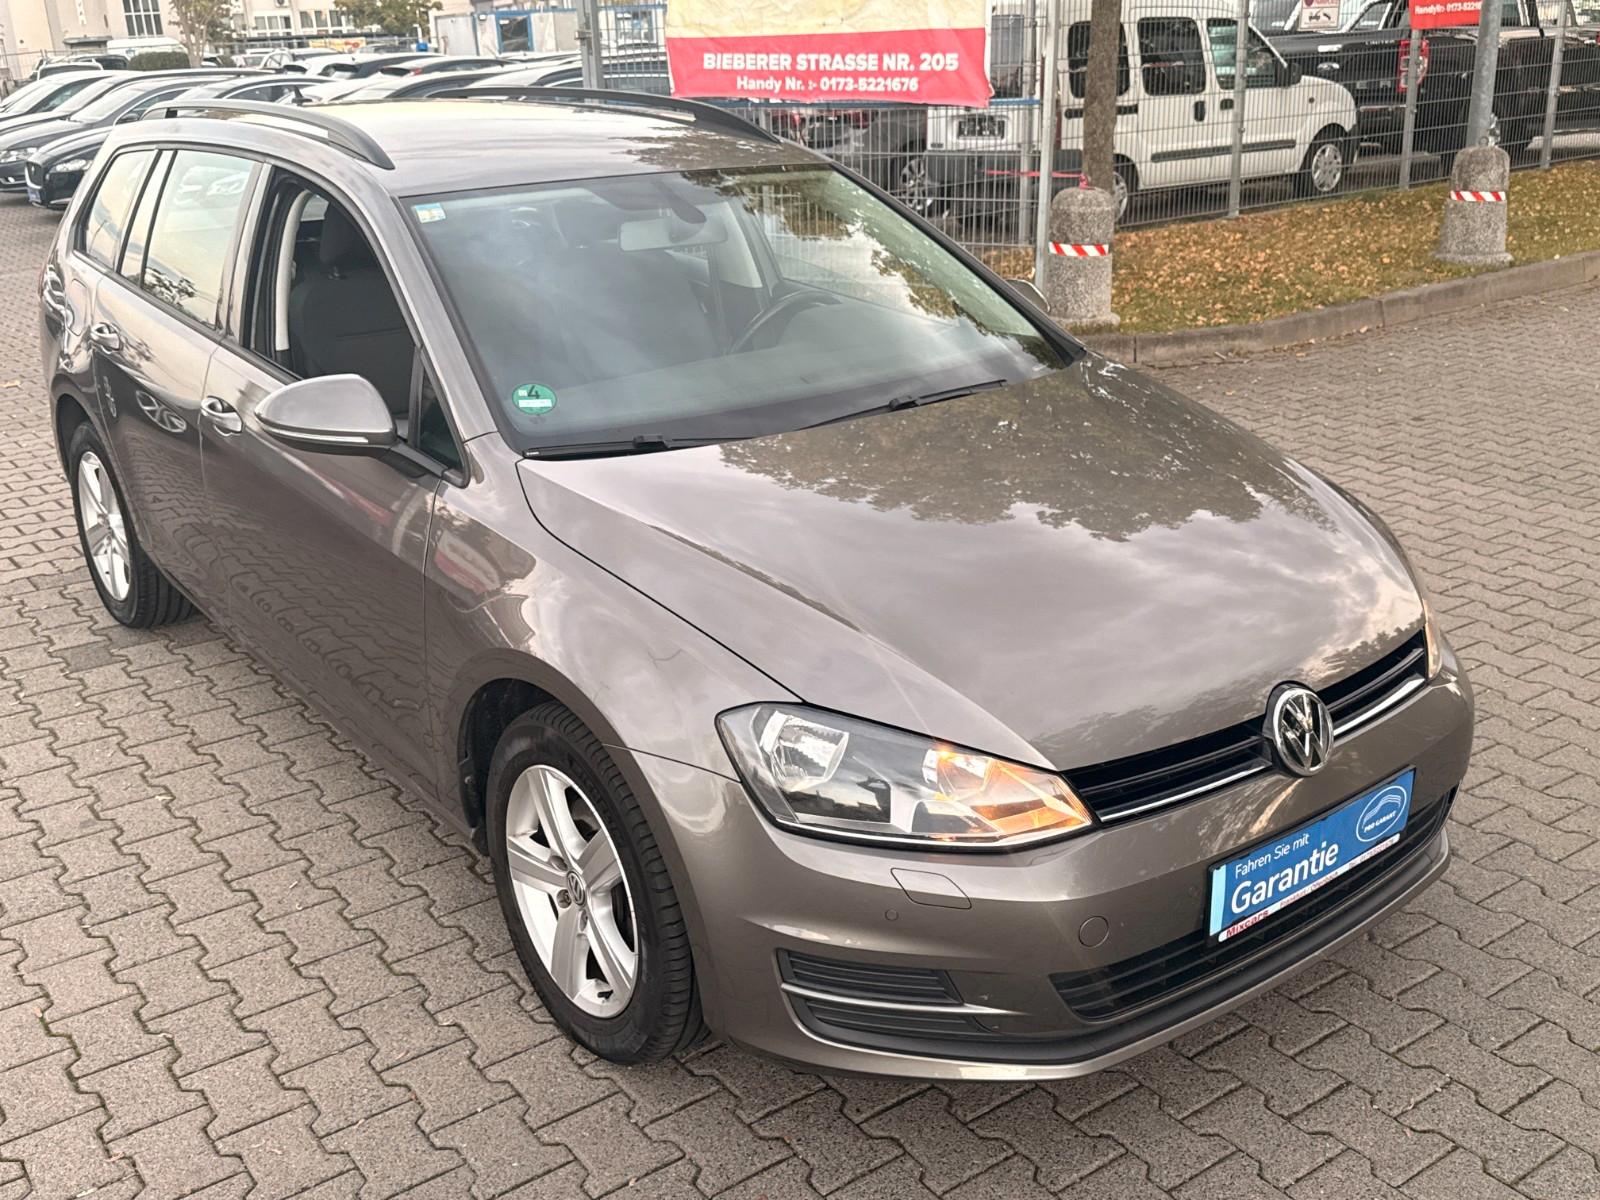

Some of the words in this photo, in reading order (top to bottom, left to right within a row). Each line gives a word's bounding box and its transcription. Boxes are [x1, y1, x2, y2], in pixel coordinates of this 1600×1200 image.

[703, 53, 792, 71] BIEBERER
[796, 53, 878, 71] STRASSE
[883, 53, 915, 71] NR.
[919, 52, 959, 71] 205
[737, 76, 782, 94] Handy
[820, 76, 919, 92] 0173-5221676
[527, 385, 540, 399] 4
[1363, 822, 1376, 833] PRO
[1235, 853, 1271, 879] Fahren
[1274, 843, 1290, 860] Sie
[1293, 833, 1310, 851] mit
[1231, 841, 1339, 914] Garantie
[1226, 909, 1269, 938] Mixcars
